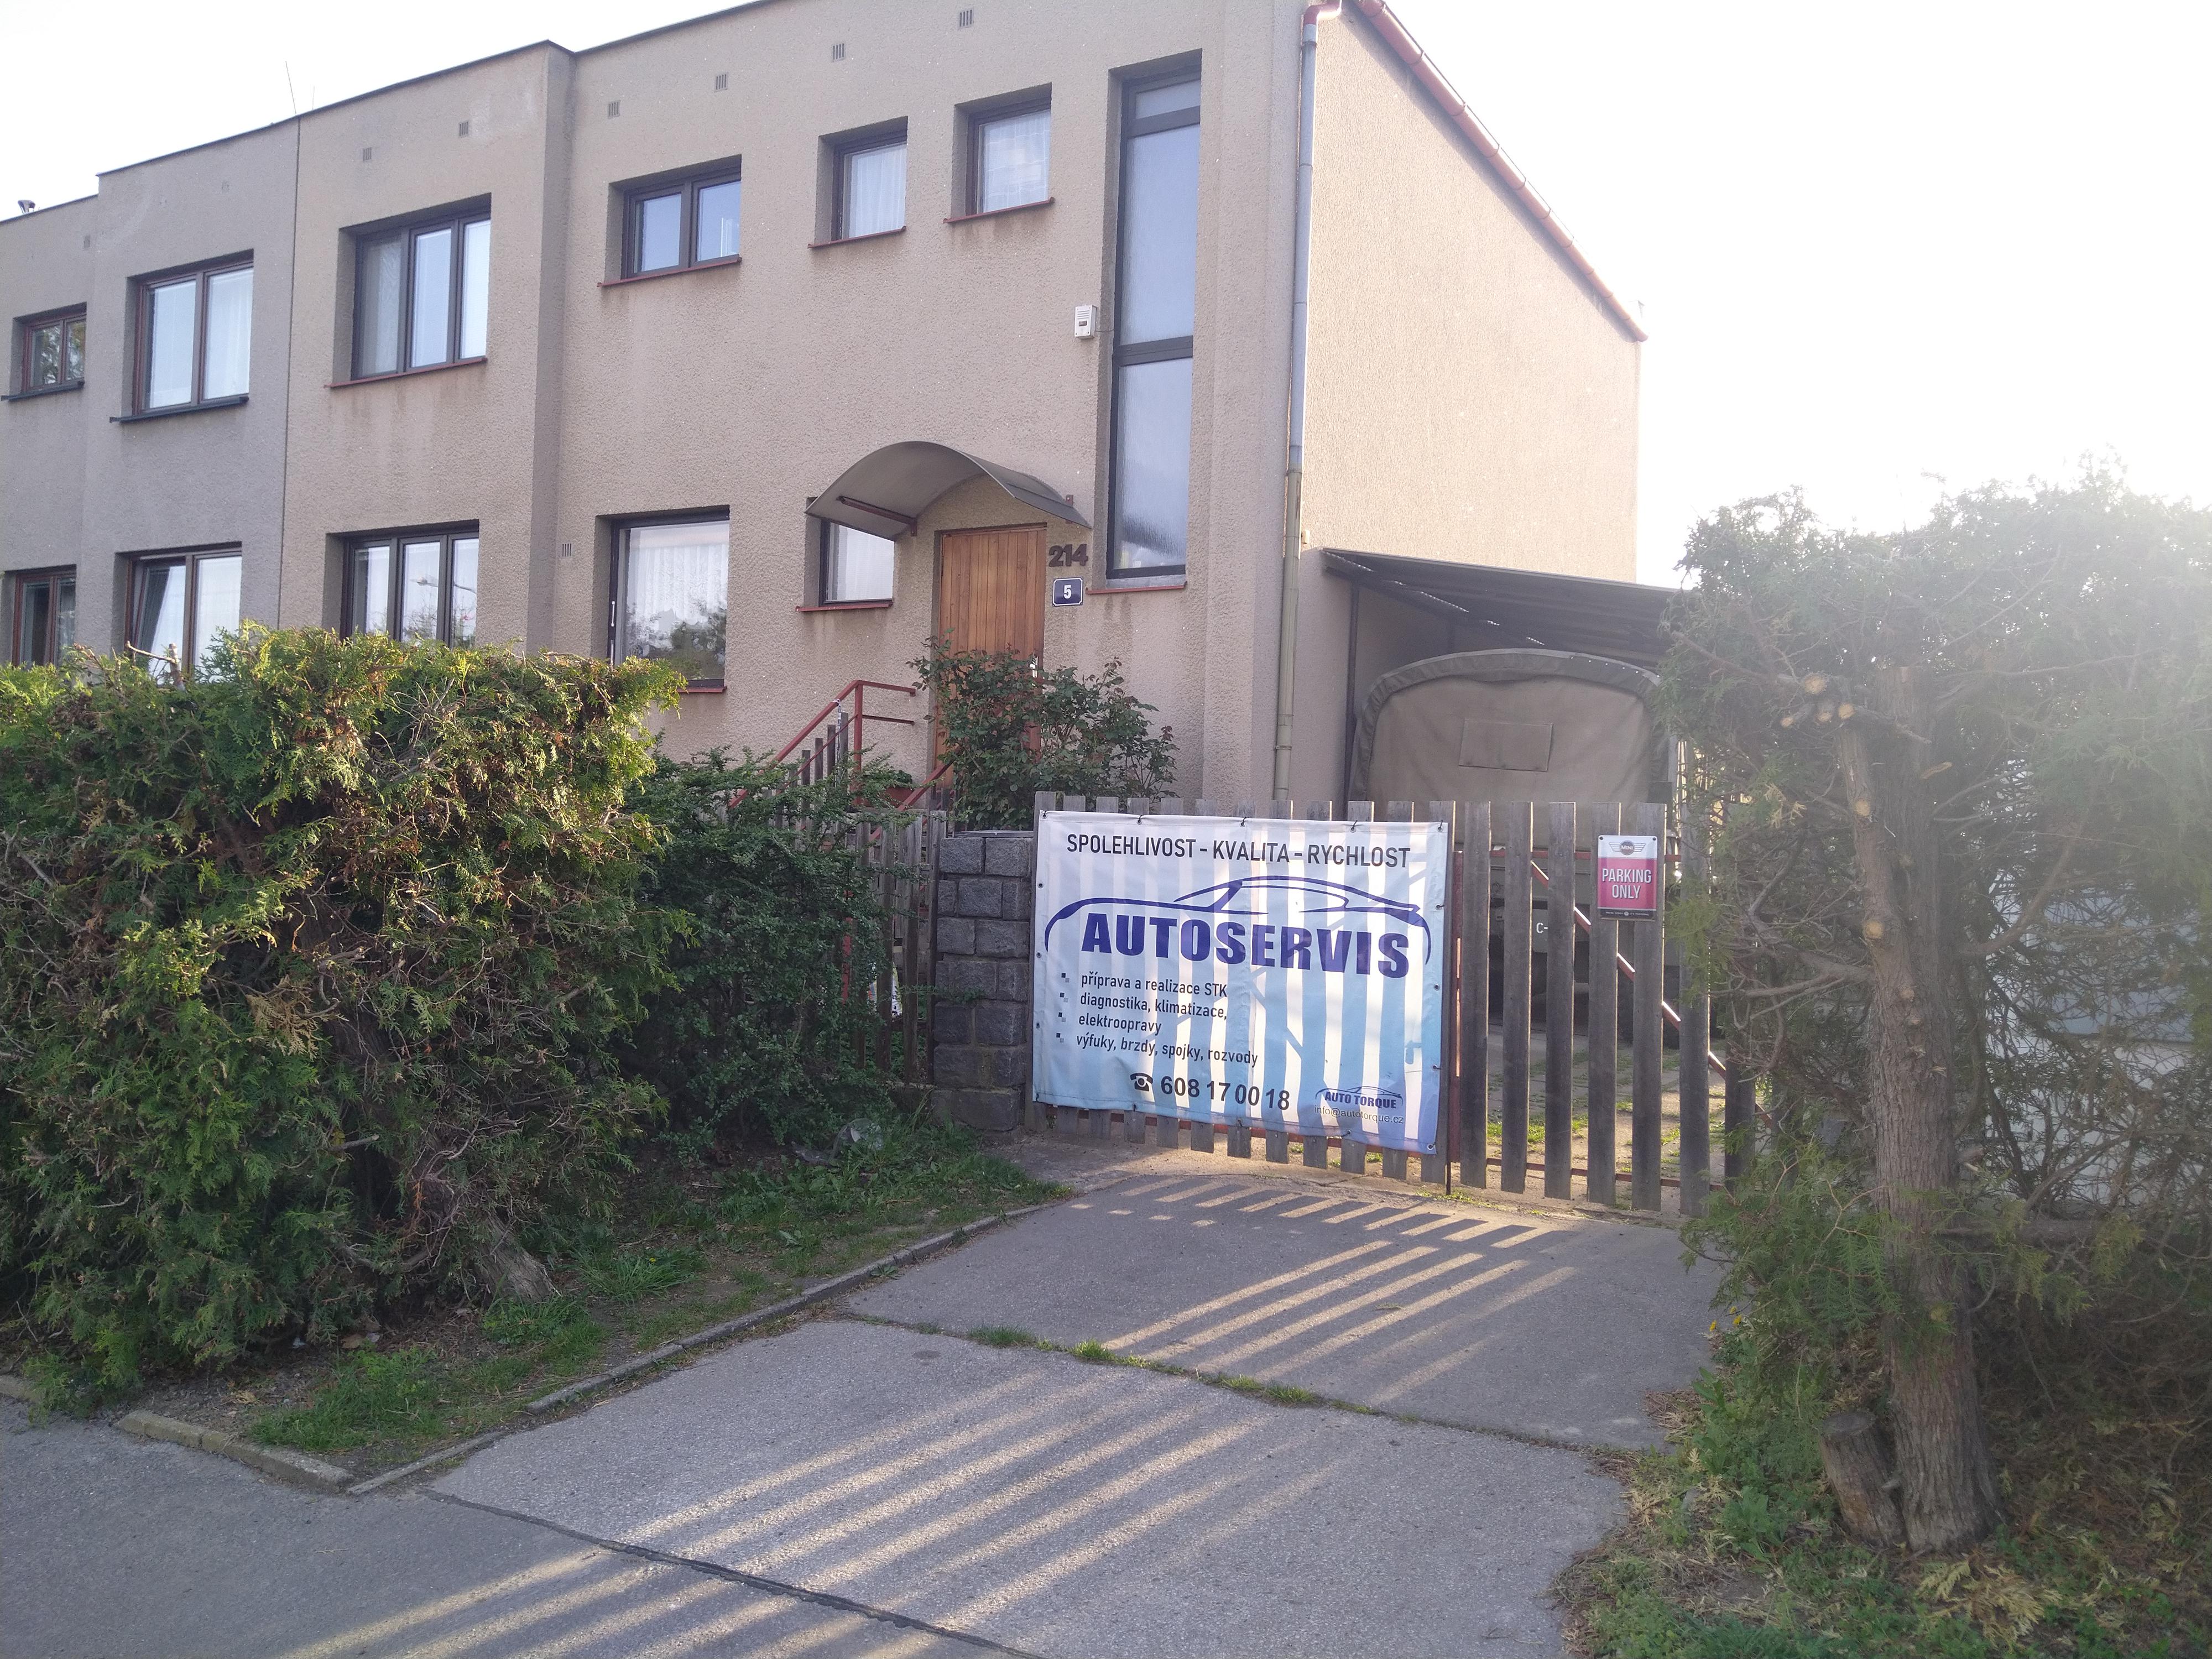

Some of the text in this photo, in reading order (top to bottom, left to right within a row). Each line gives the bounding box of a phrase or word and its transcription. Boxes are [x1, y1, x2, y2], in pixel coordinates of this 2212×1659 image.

[1048, 544, 1088, 567] 214
[1063, 585, 1072, 599] 5
[1067, 833, 1196, 858] SPOLEHLIVOST
[1213, 840, 1290, 863] KVALITA
[1308, 844, 1411, 868] RYCHLOST
[1602, 868, 1652, 884] PARKING
[1612, 885, 1641, 899] ONLY
[1081, 913, 1409, 978] AUTOSERVIS
[1081, 971, 1227, 997] příprava a realizace STK
[1080, 993, 1227, 1020] diagnostika, klimatizace,
[1079, 1014, 1162, 1036] elektroopravy
[1077, 1032, 1258, 1067] výfuky, brzdy, spojky, rozvody
[1161, 1076, 1290, 1110] 608 17 00 18
[1324, 1091, 1396, 1109] AUTO TORQUE
[1314, 1105, 1404, 1124] info@autotorque.cz
